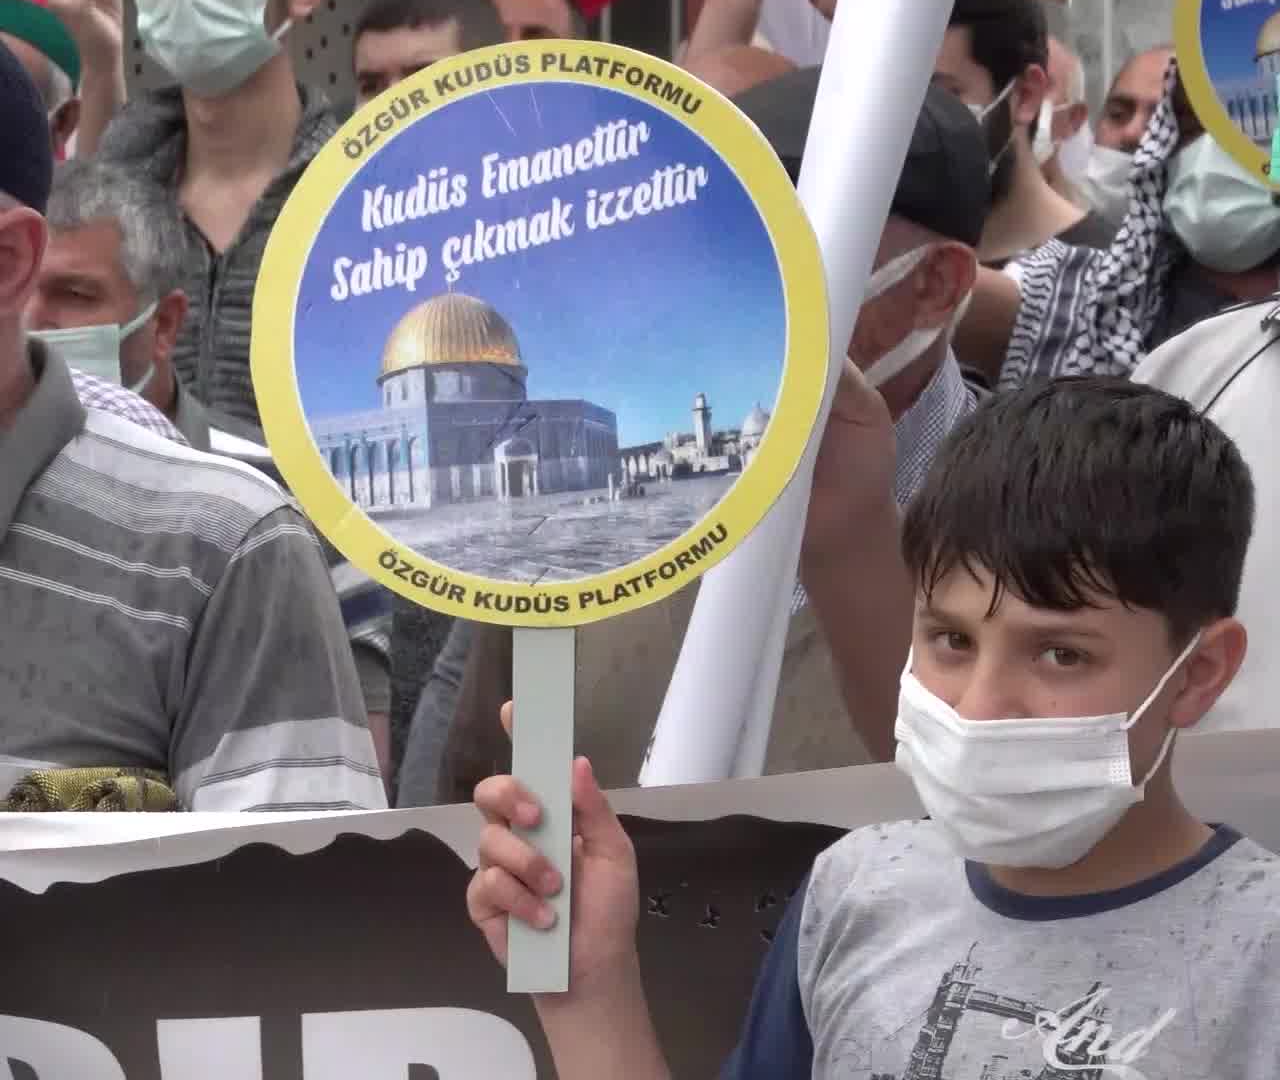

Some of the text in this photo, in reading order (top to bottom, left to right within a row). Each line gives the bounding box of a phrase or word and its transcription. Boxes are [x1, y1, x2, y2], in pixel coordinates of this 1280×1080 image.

[341, 52, 703, 160] ÖZGÜR KUDÜS PLATFORMU
[361, 118, 650, 232] Kudüs Emanettir
[330, 243, 428, 302] Sahip
[441, 197, 575, 283] çıkmak
[377, 522, 730, 614] ÖZGÜR KUDÜS PLATFORMU
